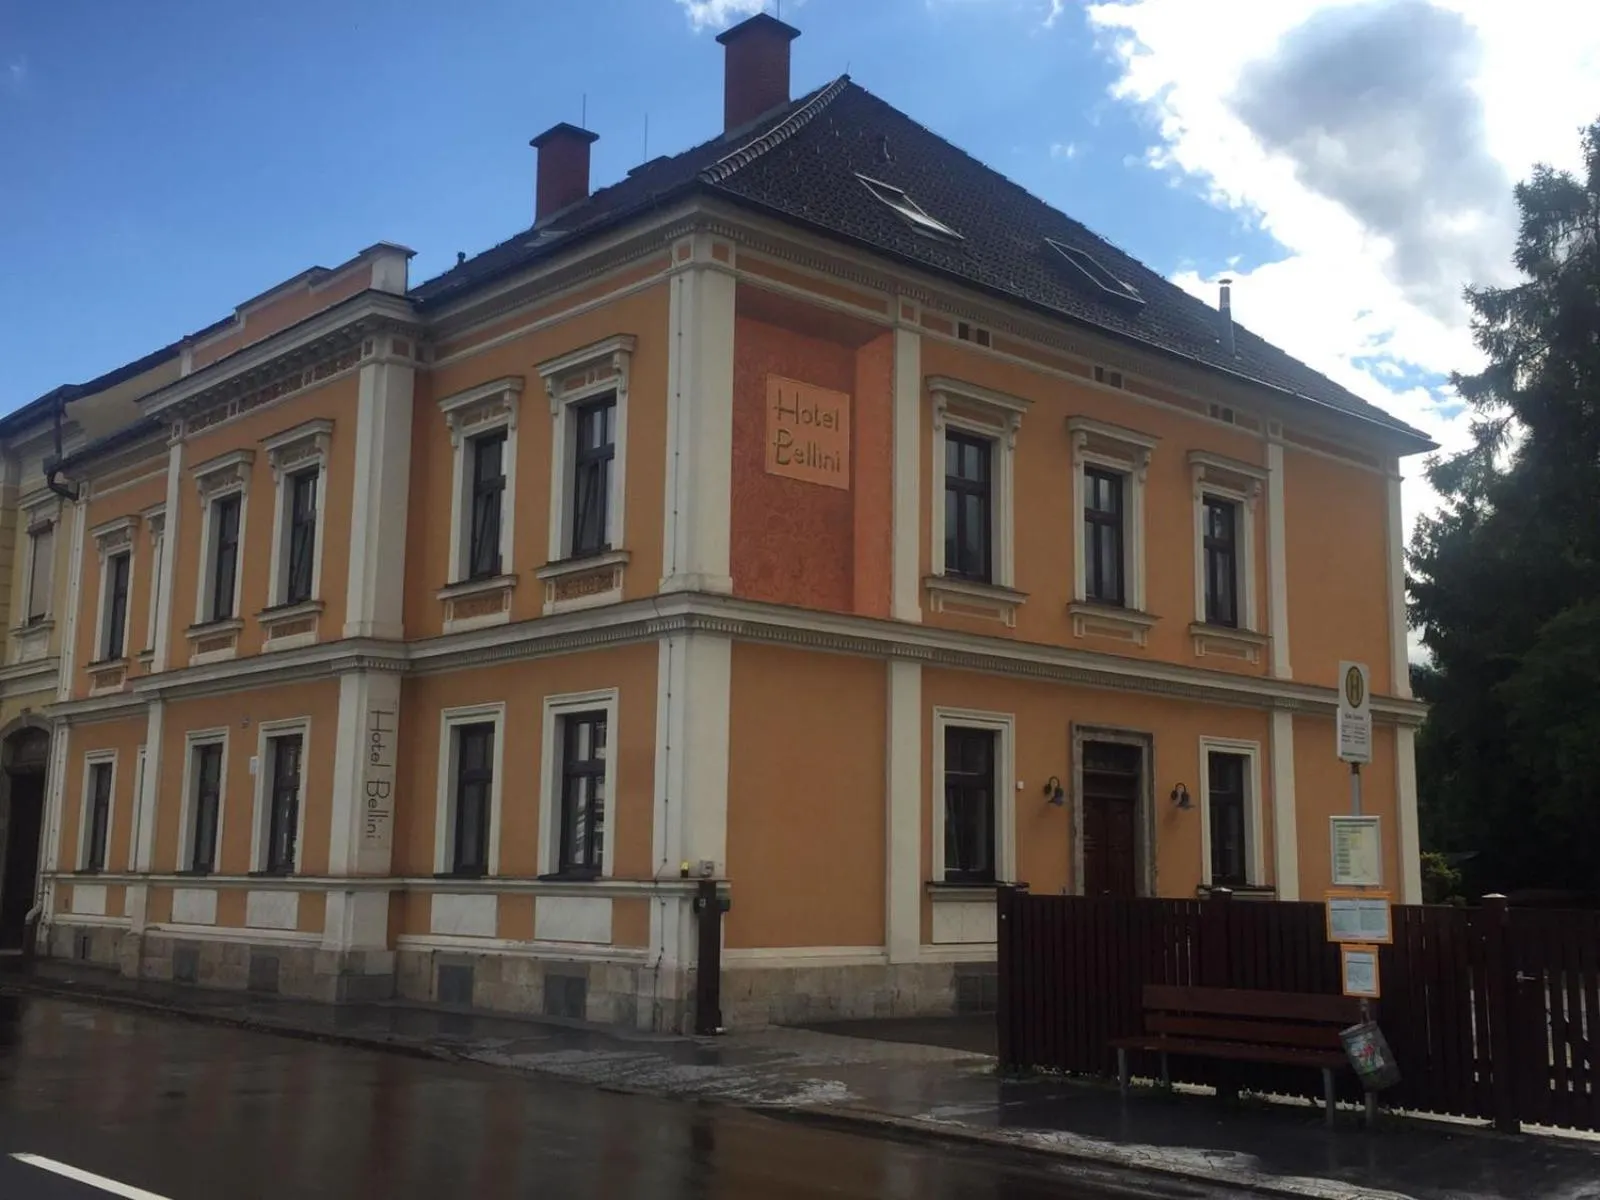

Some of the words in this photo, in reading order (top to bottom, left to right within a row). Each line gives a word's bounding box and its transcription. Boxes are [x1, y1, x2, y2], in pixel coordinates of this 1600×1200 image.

[773, 389, 840, 432] Hotel
[772, 429, 841, 473] Bellini
[1350, 673, 1361, 702] H
[370, 709, 395, 768] Hotel
[366, 779, 391, 839] Bellini
